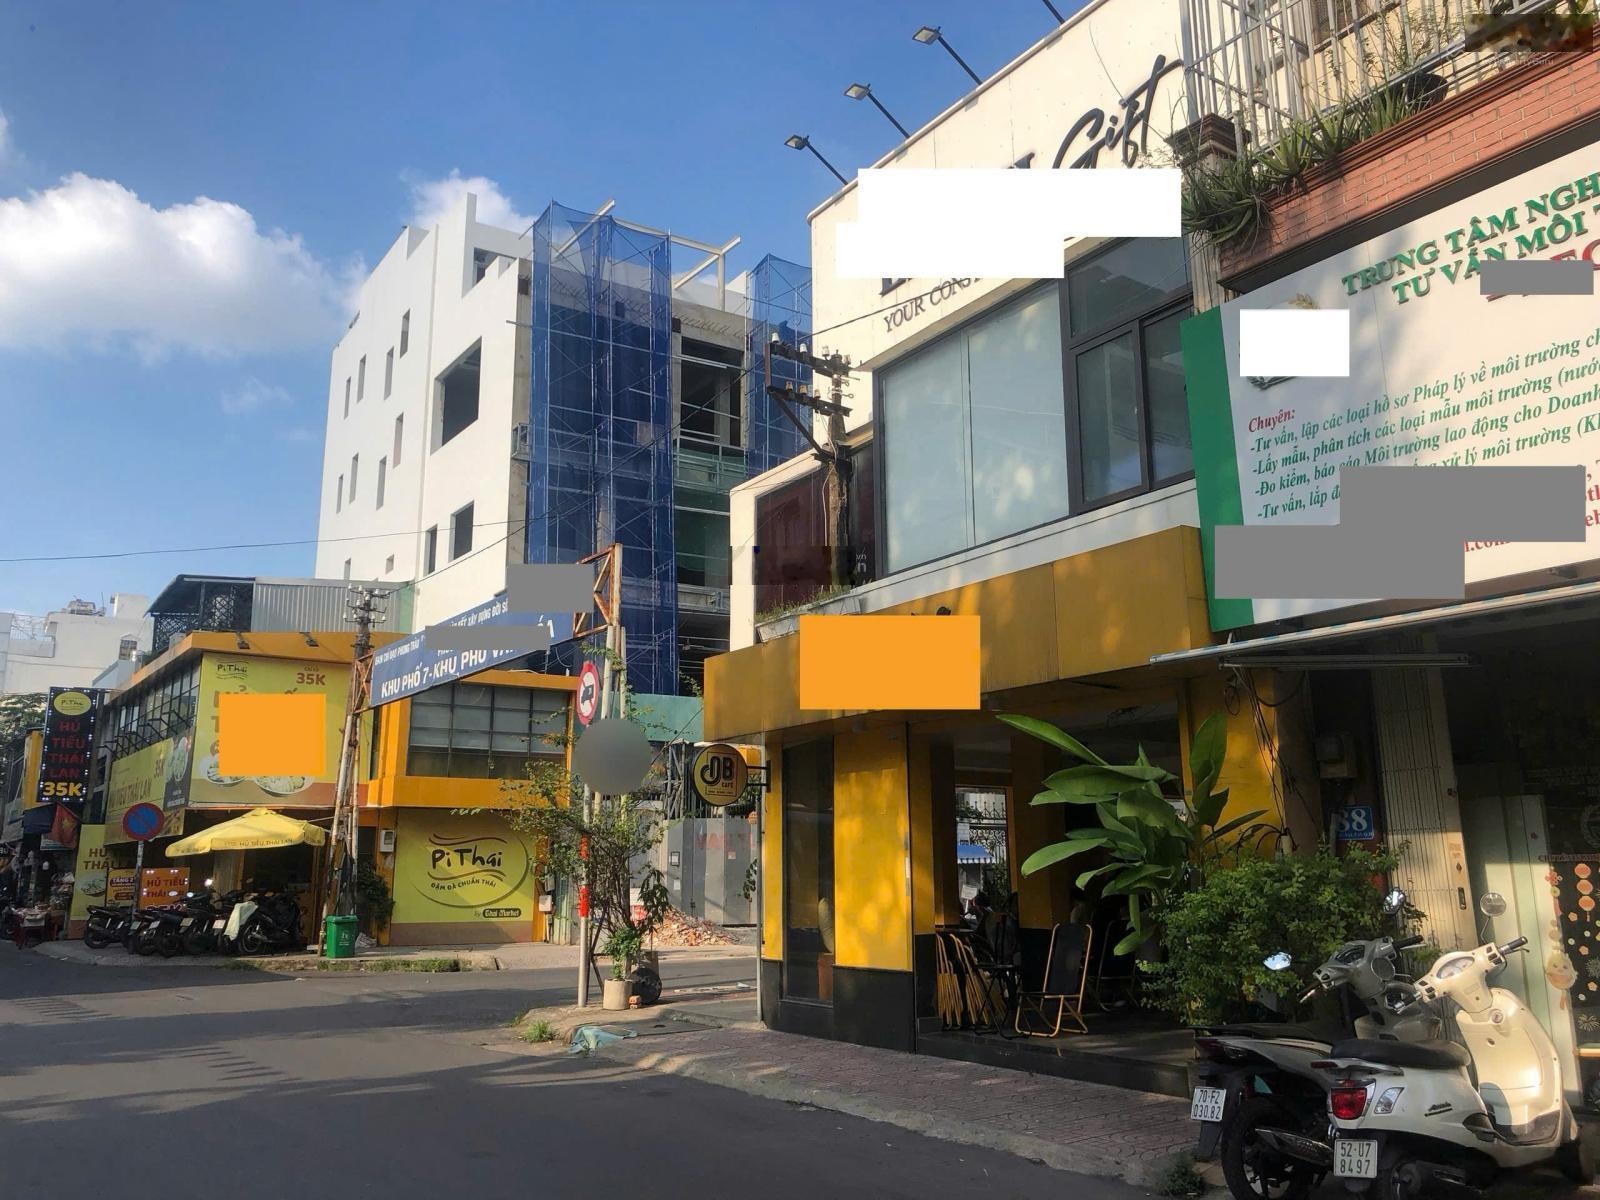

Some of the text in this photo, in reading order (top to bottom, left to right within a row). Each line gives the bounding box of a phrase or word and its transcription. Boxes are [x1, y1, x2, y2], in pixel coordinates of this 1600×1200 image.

[1052, 54, 1183, 168] Gift
[1341, 240, 1441, 297] TRUNG
[1444, 207, 1520, 254] TÂM
[1392, 267, 1436, 305] TƯ
[1514, 211, 1588, 259] MÔI
[884, 296, 926, 333] YOUR
[930, 278, 983, 306] CONS
[1250, 437, 1272, 454] -Tư
[1274, 425, 1298, 447] vấn,
[1301, 422, 1319, 440] lập
[1322, 413, 1343, 431] các
[1346, 402, 1370, 423] loại
[1373, 394, 1390, 415] hồ
[1393, 394, 1410, 410] sơ
[1412, 379, 1449, 403] Pháp
[1453, 371, 1466, 394] lý
[1470, 360, 1487, 384] về
[1491, 355, 1520, 378] môi
[1524, 339, 1581, 368] trường
[1248, 408, 1296, 433] Chuyên:
[1252, 452, 1279, 475] -Lấy
[1281, 445, 1311, 468] mẫu,
[1313, 438, 1344, 462] phân
[1347, 427, 1371, 447] tích
[1374, 420, 1397, 439] các
[1400, 410, 1426, 432] loại
[1430, 398, 1461, 423] mẫu
[1465, 389, 1494, 412] môi
[1498, 376, 1553, 403] trường
[1255, 480, 1276, 497] -Đo
[1279, 468, 1311, 491] kiểm,
[1314, 462, 1336, 481] báo
[1364, 445, 1391, 466] Môi
[1393, 436, 1441, 458] trường
[1444, 428, 1467, 444] lao
[1471, 415, 1509, 437] động
[1513, 405, 1542, 424] cho
[1464, 446, 1478, 466] lý
[1482, 438, 1511, 461] môi
[1515, 426, 1572, 452] trường
[1258, 503, 1280, 519] -Tư
[1282, 492, 1306, 513] vấn,
[1309, 485, 1328, 508] lắp
[296, 672, 326, 686] 35K
[381, 677, 401, 699] KHU
[402, 661, 423, 692] PHỐ
[43, 781, 83, 797] 35K
[1193, 1104, 1221, 1121] 030.82
[1339, 1159, 1371, 1176] 8497
